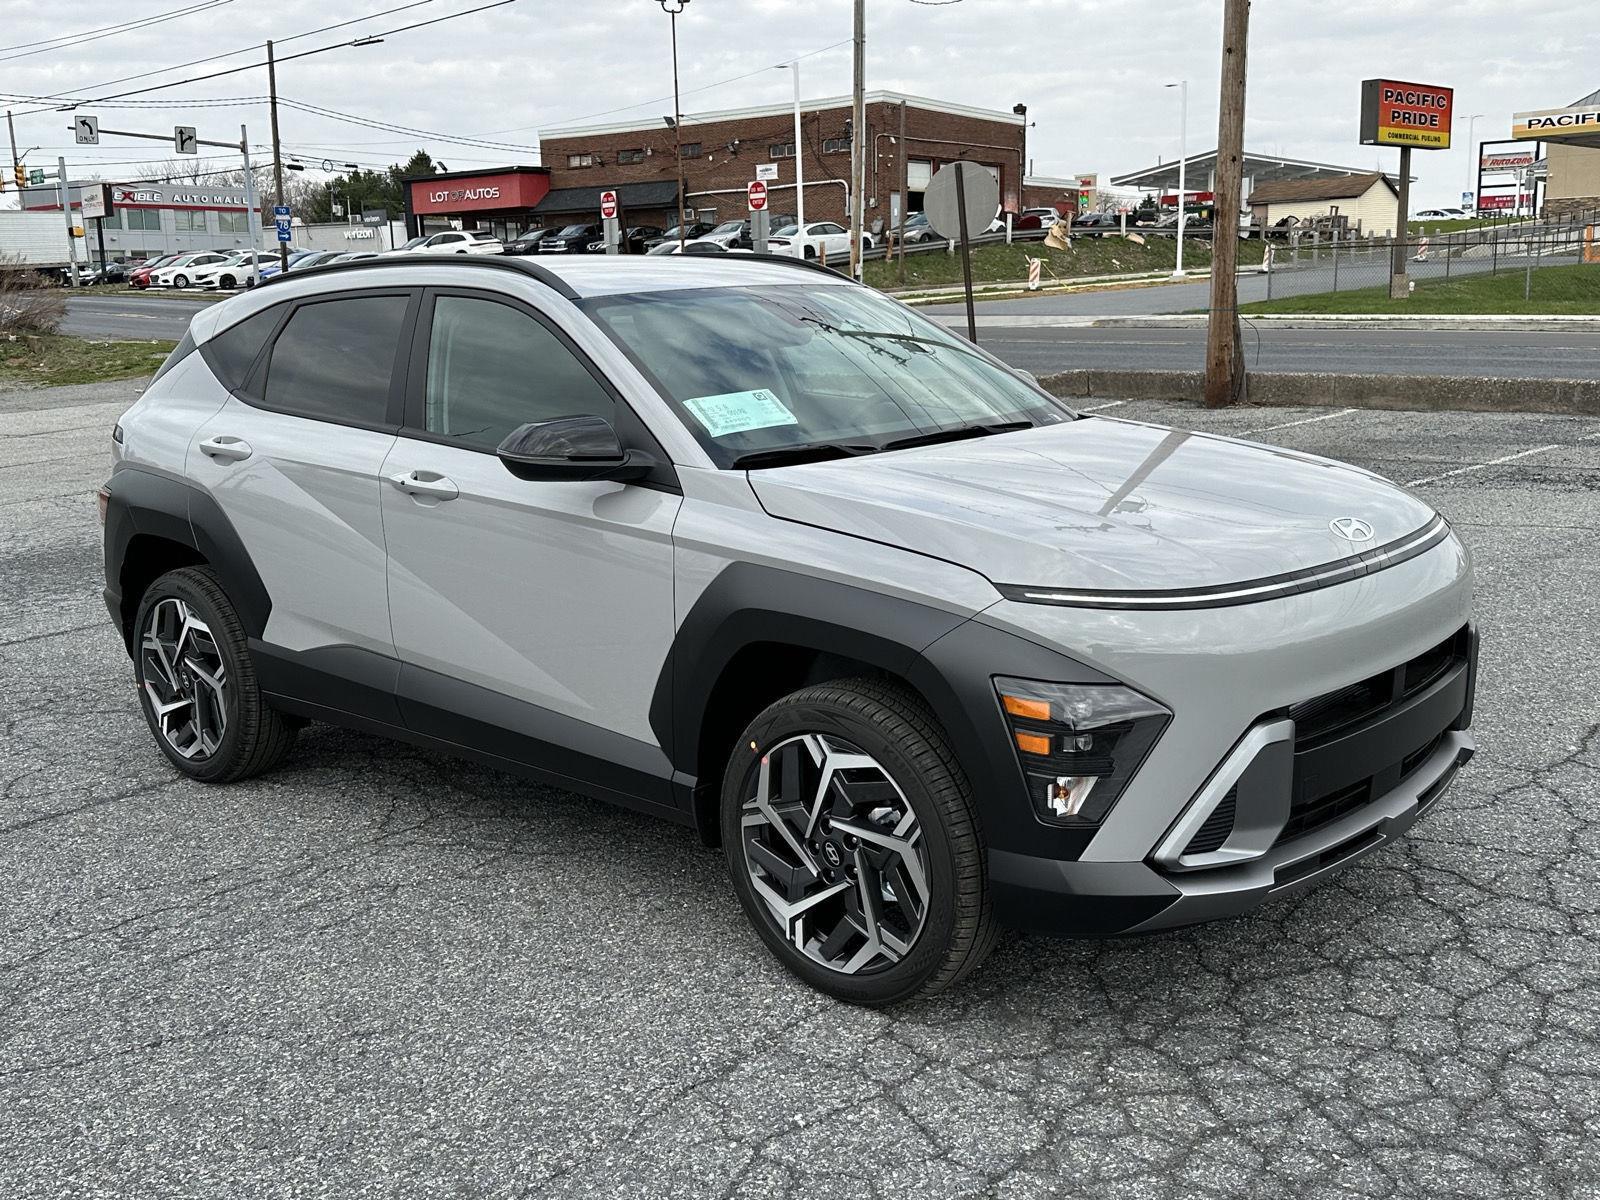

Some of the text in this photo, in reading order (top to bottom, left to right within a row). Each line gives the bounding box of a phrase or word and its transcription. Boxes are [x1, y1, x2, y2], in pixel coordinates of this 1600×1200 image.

[1384, 88, 1446, 109] PACIFIC
[1391, 109, 1439, 127] PRIDE
[1387, 131, 1441, 143] COMMERCIAL FUELING
[173, 194, 208, 203] AUTO
[212, 195, 249, 205] MALL
[430, 187, 500, 202] LOT OF AUTOS
[278, 220, 289, 230] 78
[343, 229, 374, 239] verizon
